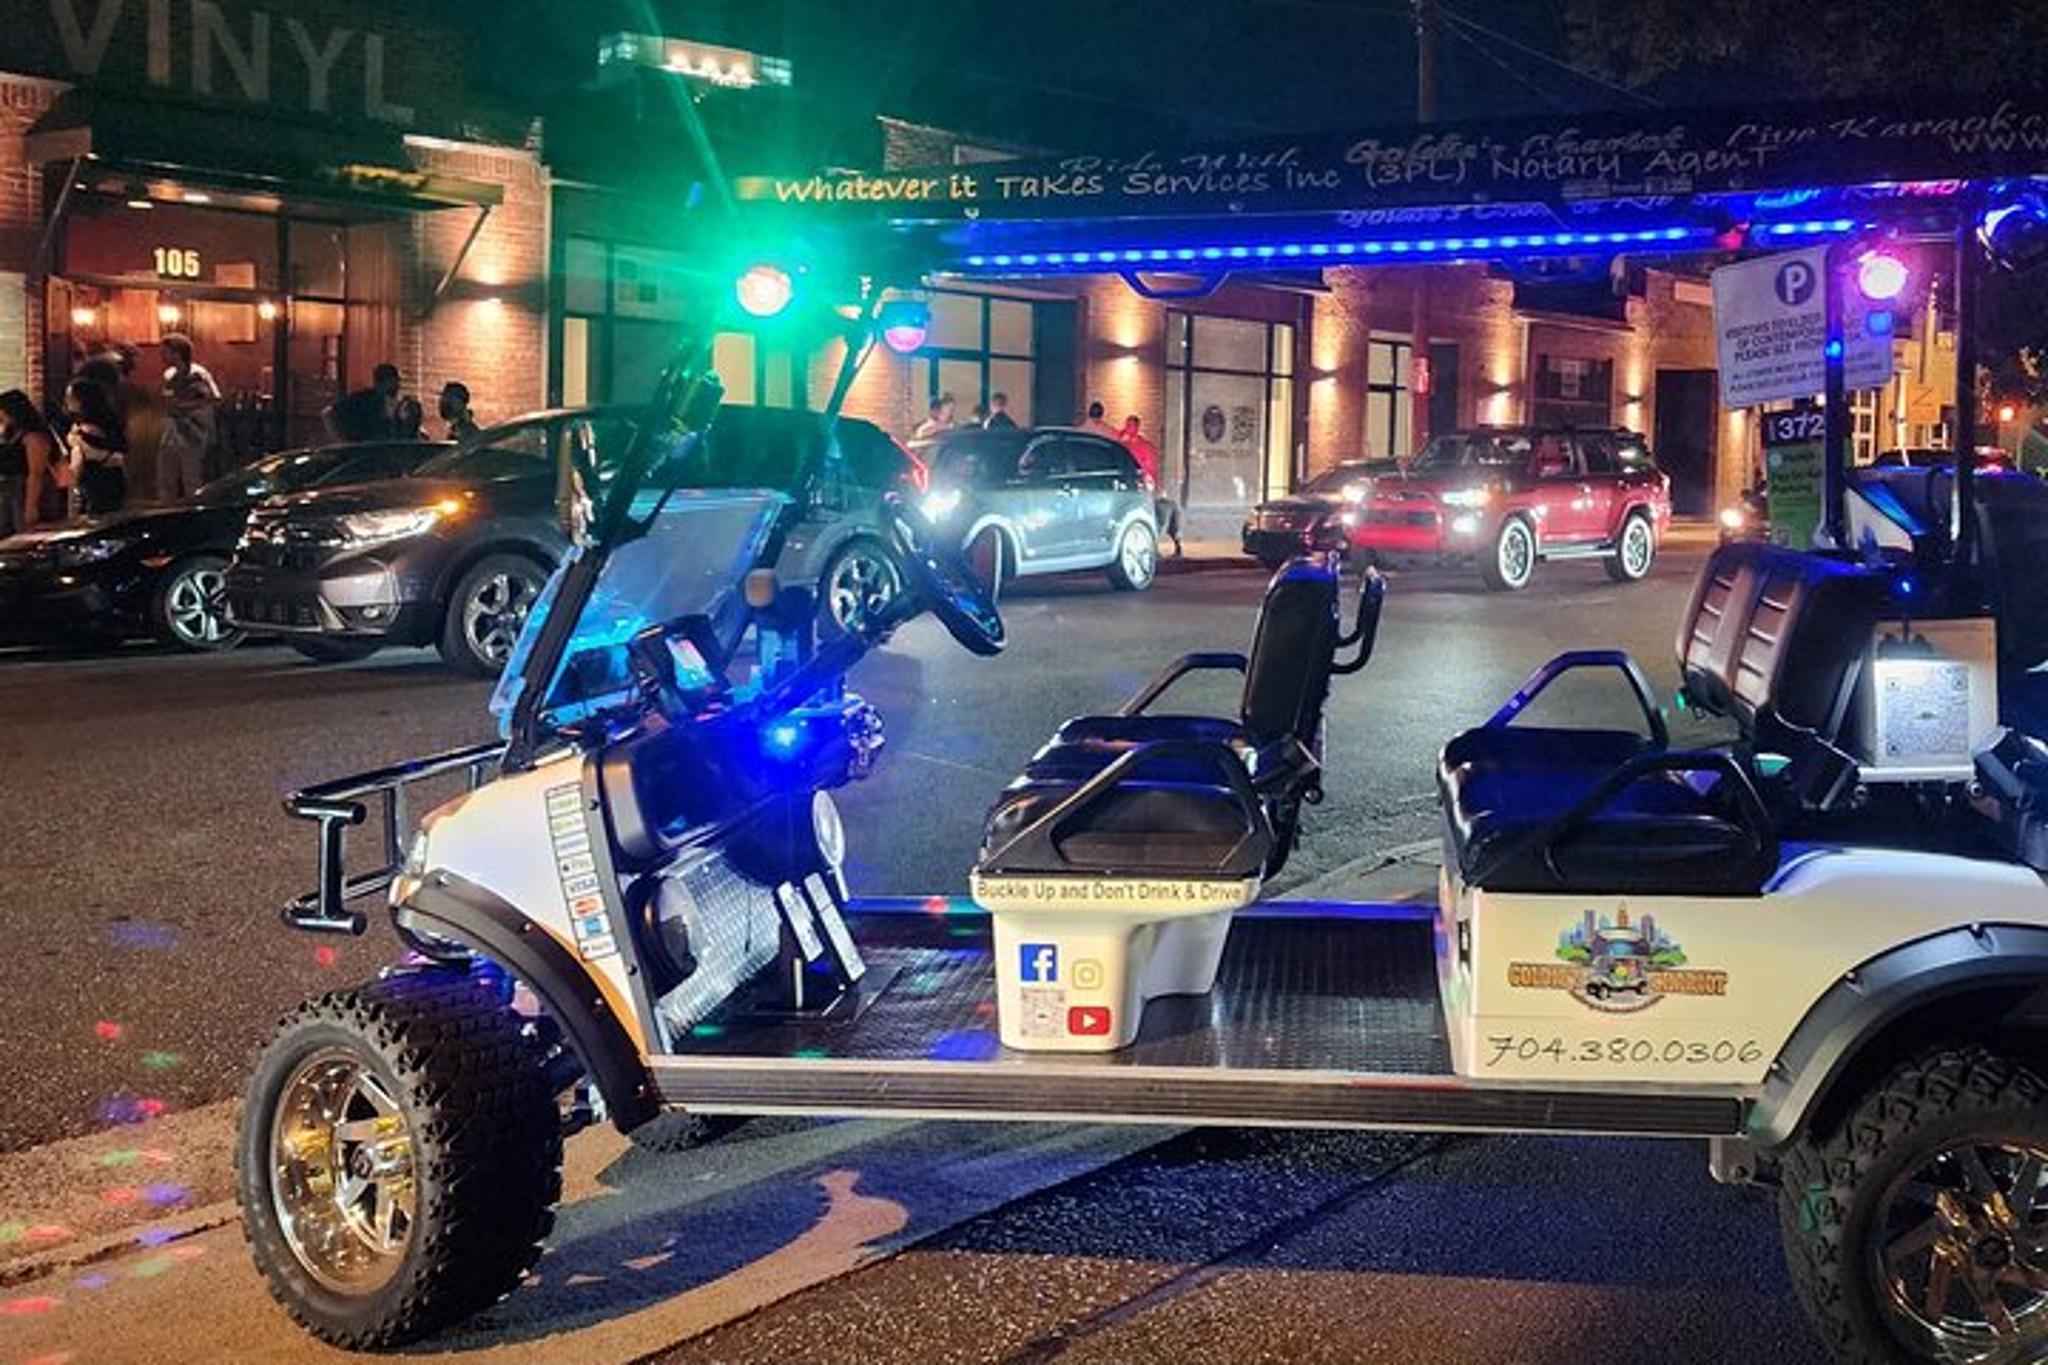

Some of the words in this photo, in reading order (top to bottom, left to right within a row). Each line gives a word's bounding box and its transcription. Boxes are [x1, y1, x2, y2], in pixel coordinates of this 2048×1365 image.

[49, 0, 415, 126] VINYL
[949, 174, 978, 199] it
[1122, 172, 1271, 195] Services
[1286, 166, 1342, 190] Inc
[1492, 151, 1619, 180] Notary
[153, 247, 200, 277] 105
[977, 881, 1029, 899] Buckle
[1033, 883, 1055, 902] Up
[1060, 883, 1088, 899] and
[1093, 883, 1136, 899] Don't
[1138, 883, 1179, 899] Drink
[1185, 884, 1196, 899] &
[1200, 883, 1242, 900] Drive
[1486, 1034, 1763, 1067] 704.380.0306
